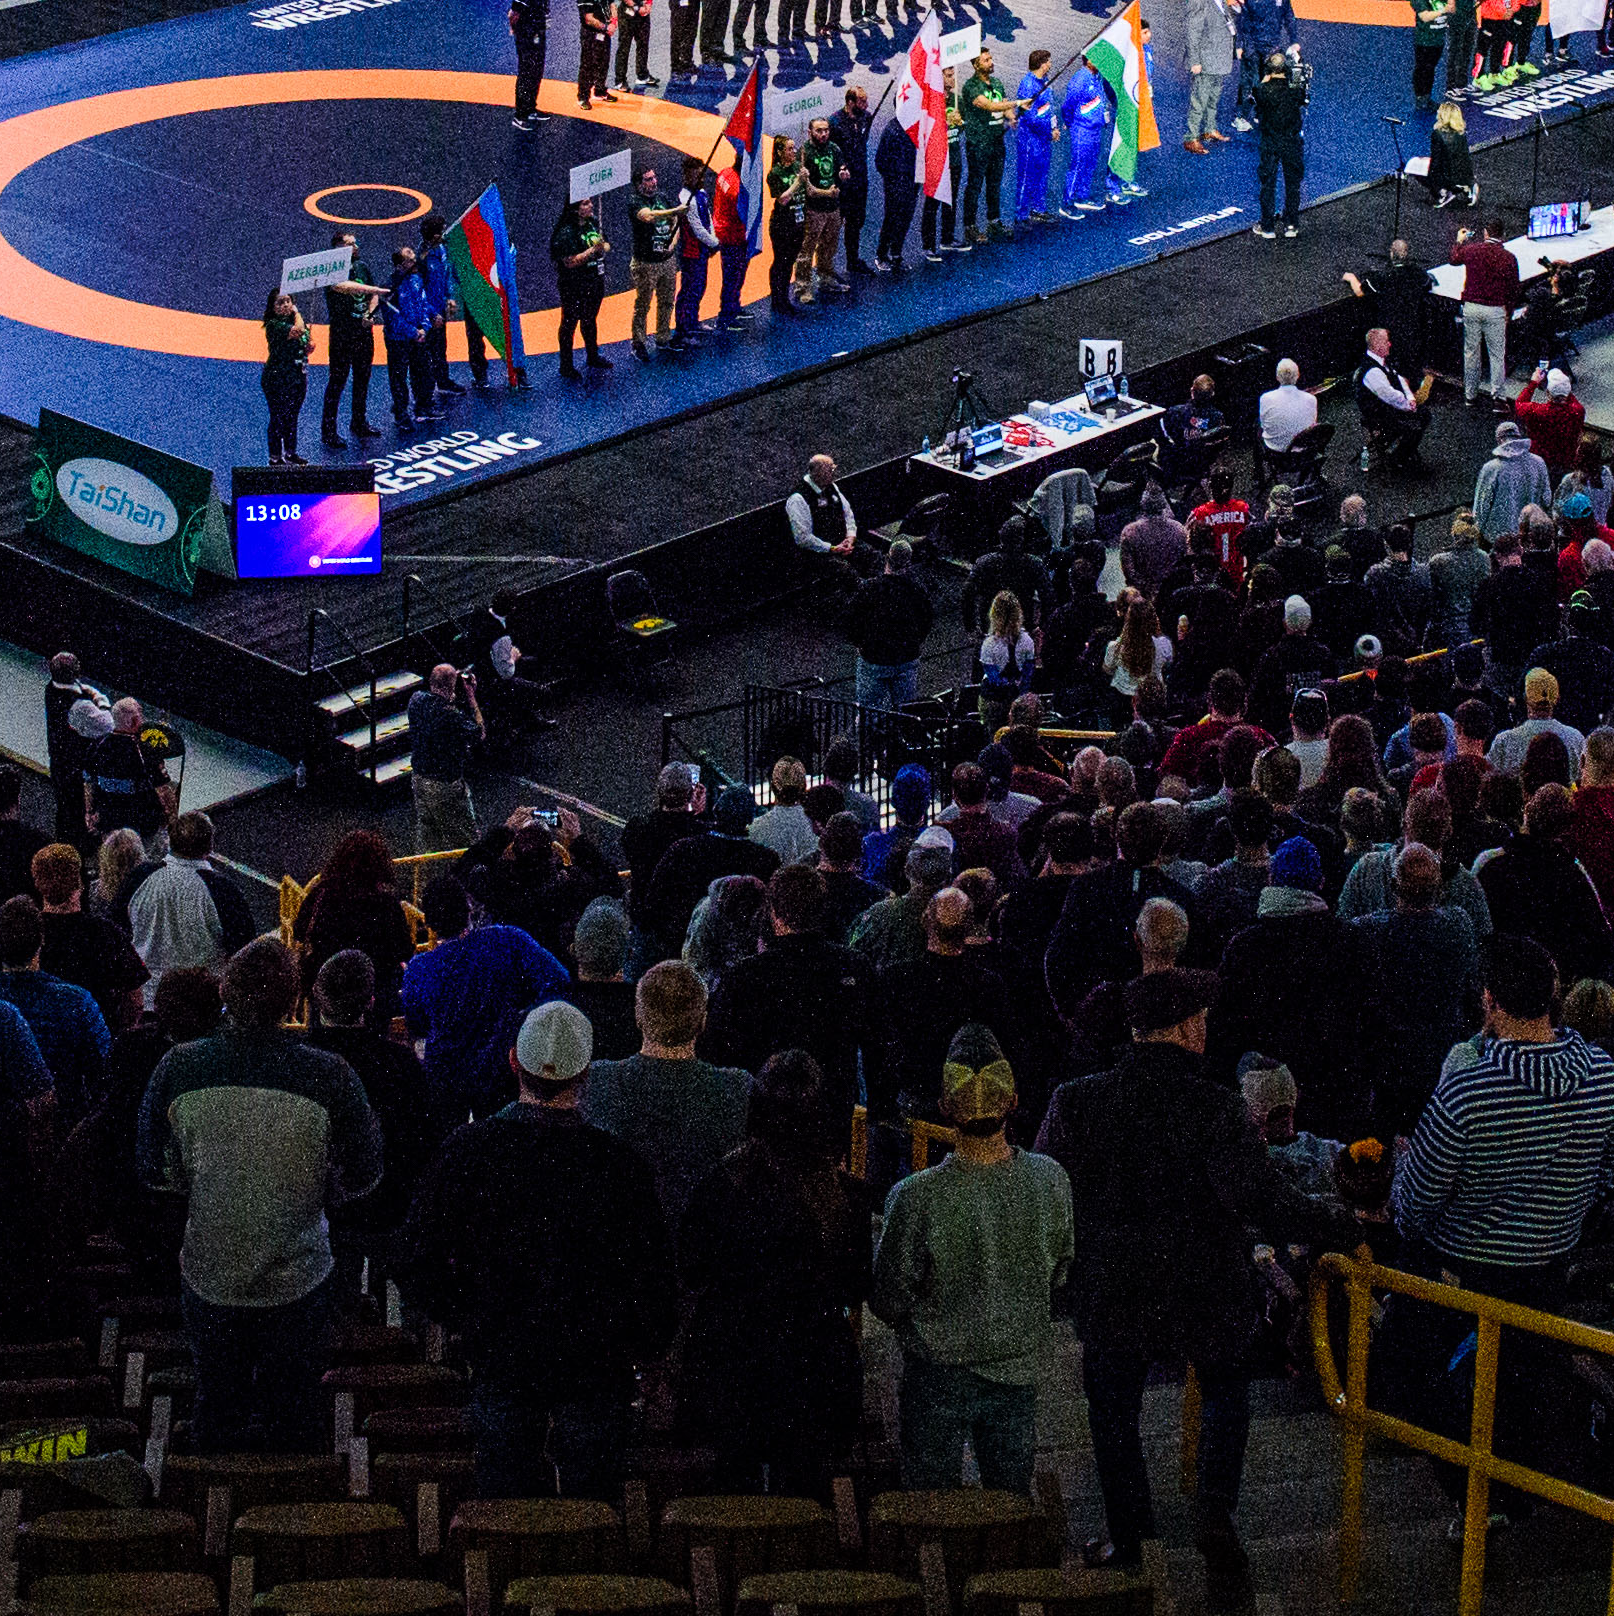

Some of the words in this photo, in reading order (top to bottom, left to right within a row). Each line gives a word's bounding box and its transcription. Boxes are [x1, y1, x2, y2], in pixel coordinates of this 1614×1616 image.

[248, 0, 321, 19] UNITED
[782, 95, 823, 116] GEORGIA
[589, 167, 613, 185] CUBA
[1085, 345, 1095, 377] B
[1107, 347, 1117, 376] B
[387, 430, 480, 463] WORLD
[70, 470, 166, 533] TaiShan
[246, 503, 302, 522] 13:08
